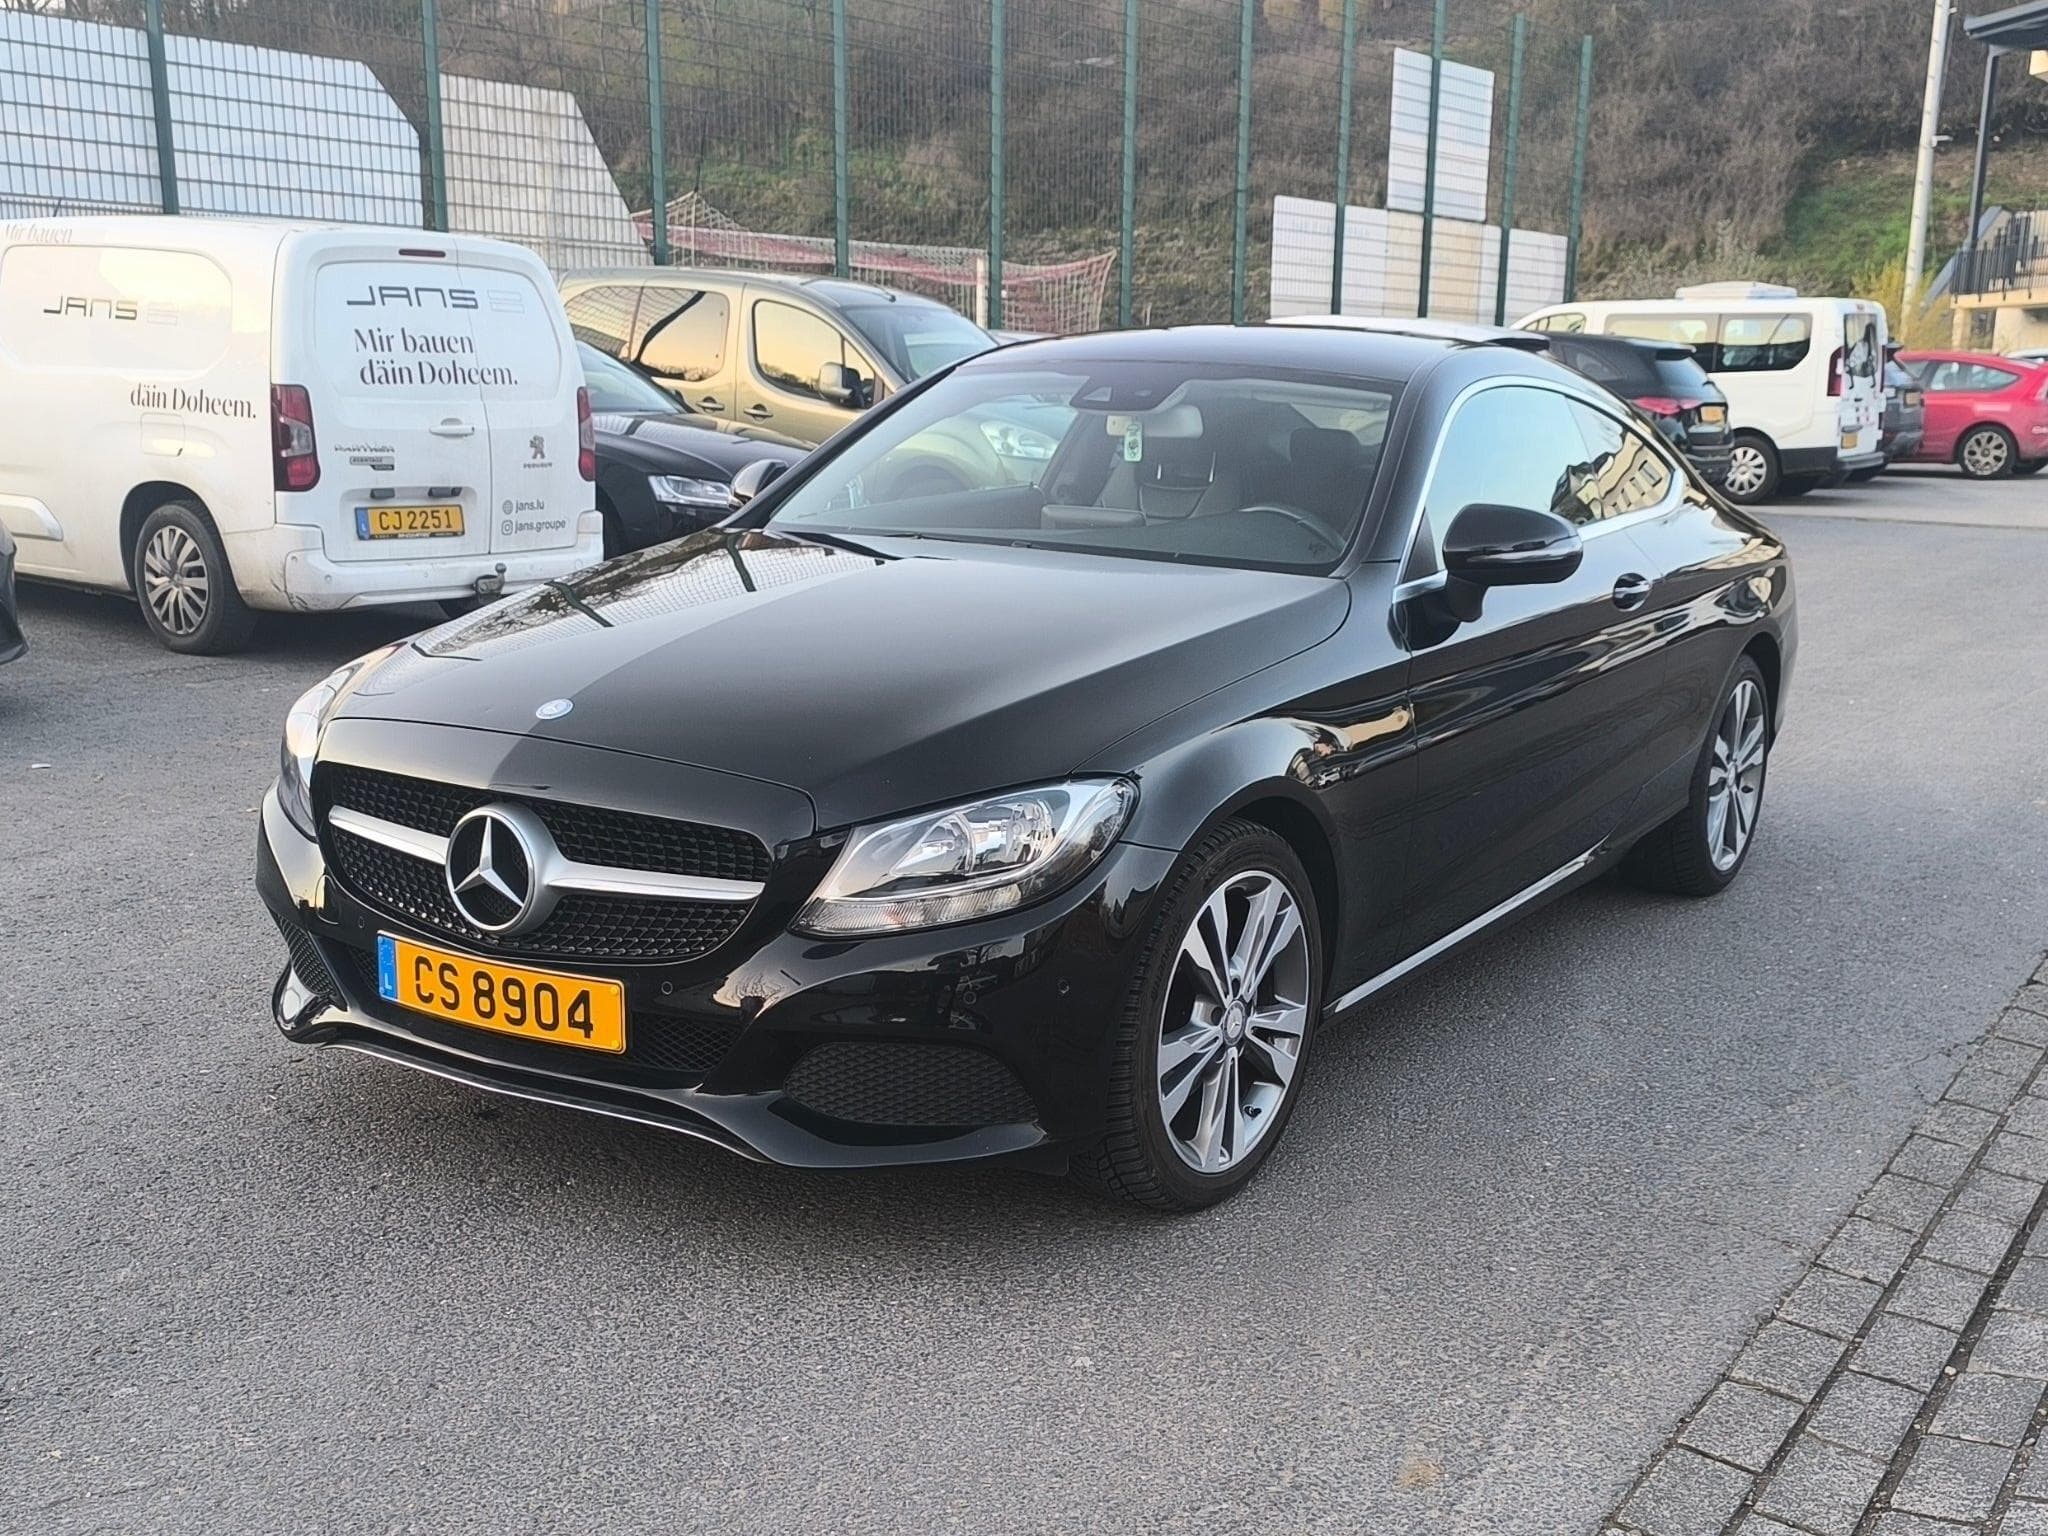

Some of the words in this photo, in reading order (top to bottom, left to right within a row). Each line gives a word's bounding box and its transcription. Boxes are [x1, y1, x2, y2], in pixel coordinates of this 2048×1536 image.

[354, 327, 395, 353] Mir
[400, 327, 474, 354] bauen
[359, 359, 412, 385] däin
[418, 359, 518, 386] Doheem.
[130, 383, 167, 410] däin
[172, 387, 257, 419] Doheem.
[379, 511, 402, 531] CJ
[407, 509, 453, 530] 2251
[515, 499, 545, 514] jans.lu
[515, 519, 566, 534] jans.groupe
[414, 956, 460, 1011] CS
[473, 970, 594, 1039] 8904
